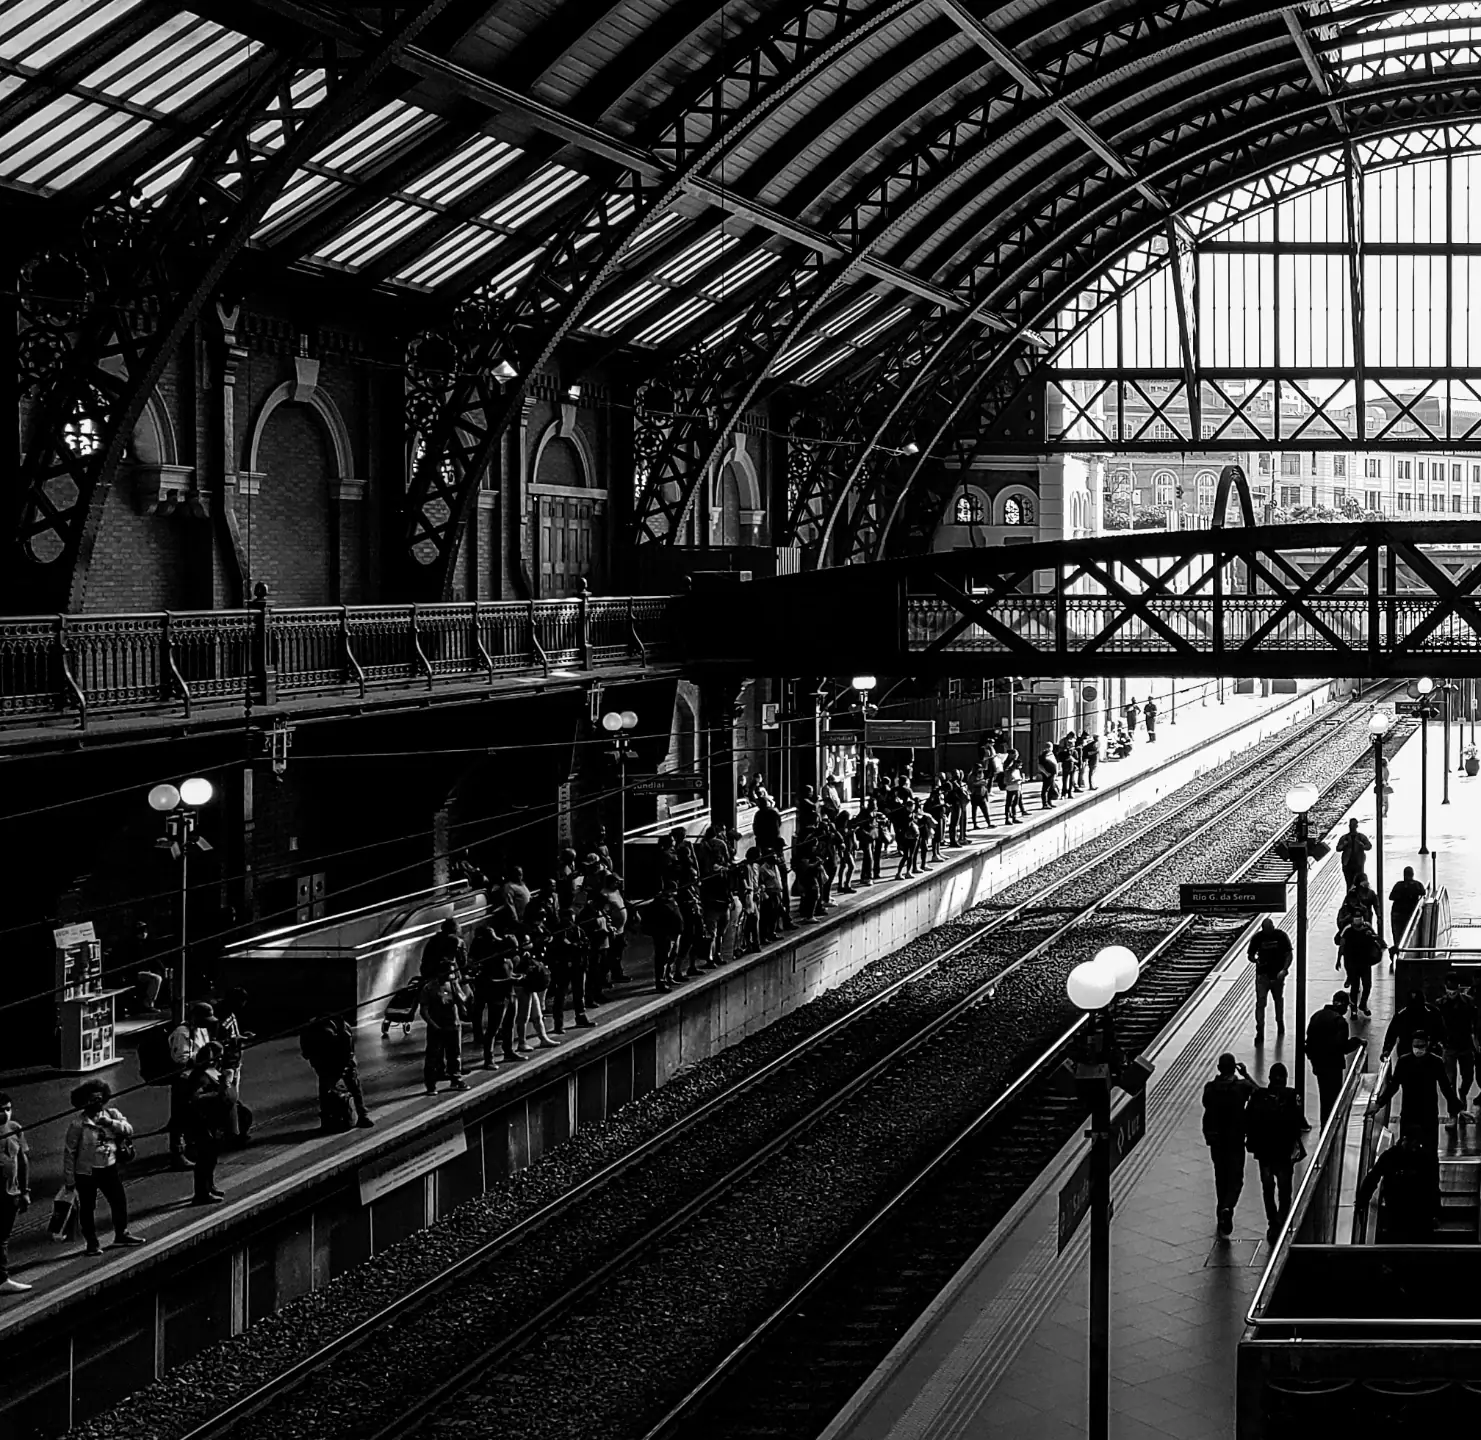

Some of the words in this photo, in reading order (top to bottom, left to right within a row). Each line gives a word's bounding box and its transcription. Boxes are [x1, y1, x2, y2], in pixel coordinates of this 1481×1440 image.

[1192, 893, 1207, 901] Rio
[1220, 893, 1231, 901] da
[1232, 893, 1256, 901] Serra
